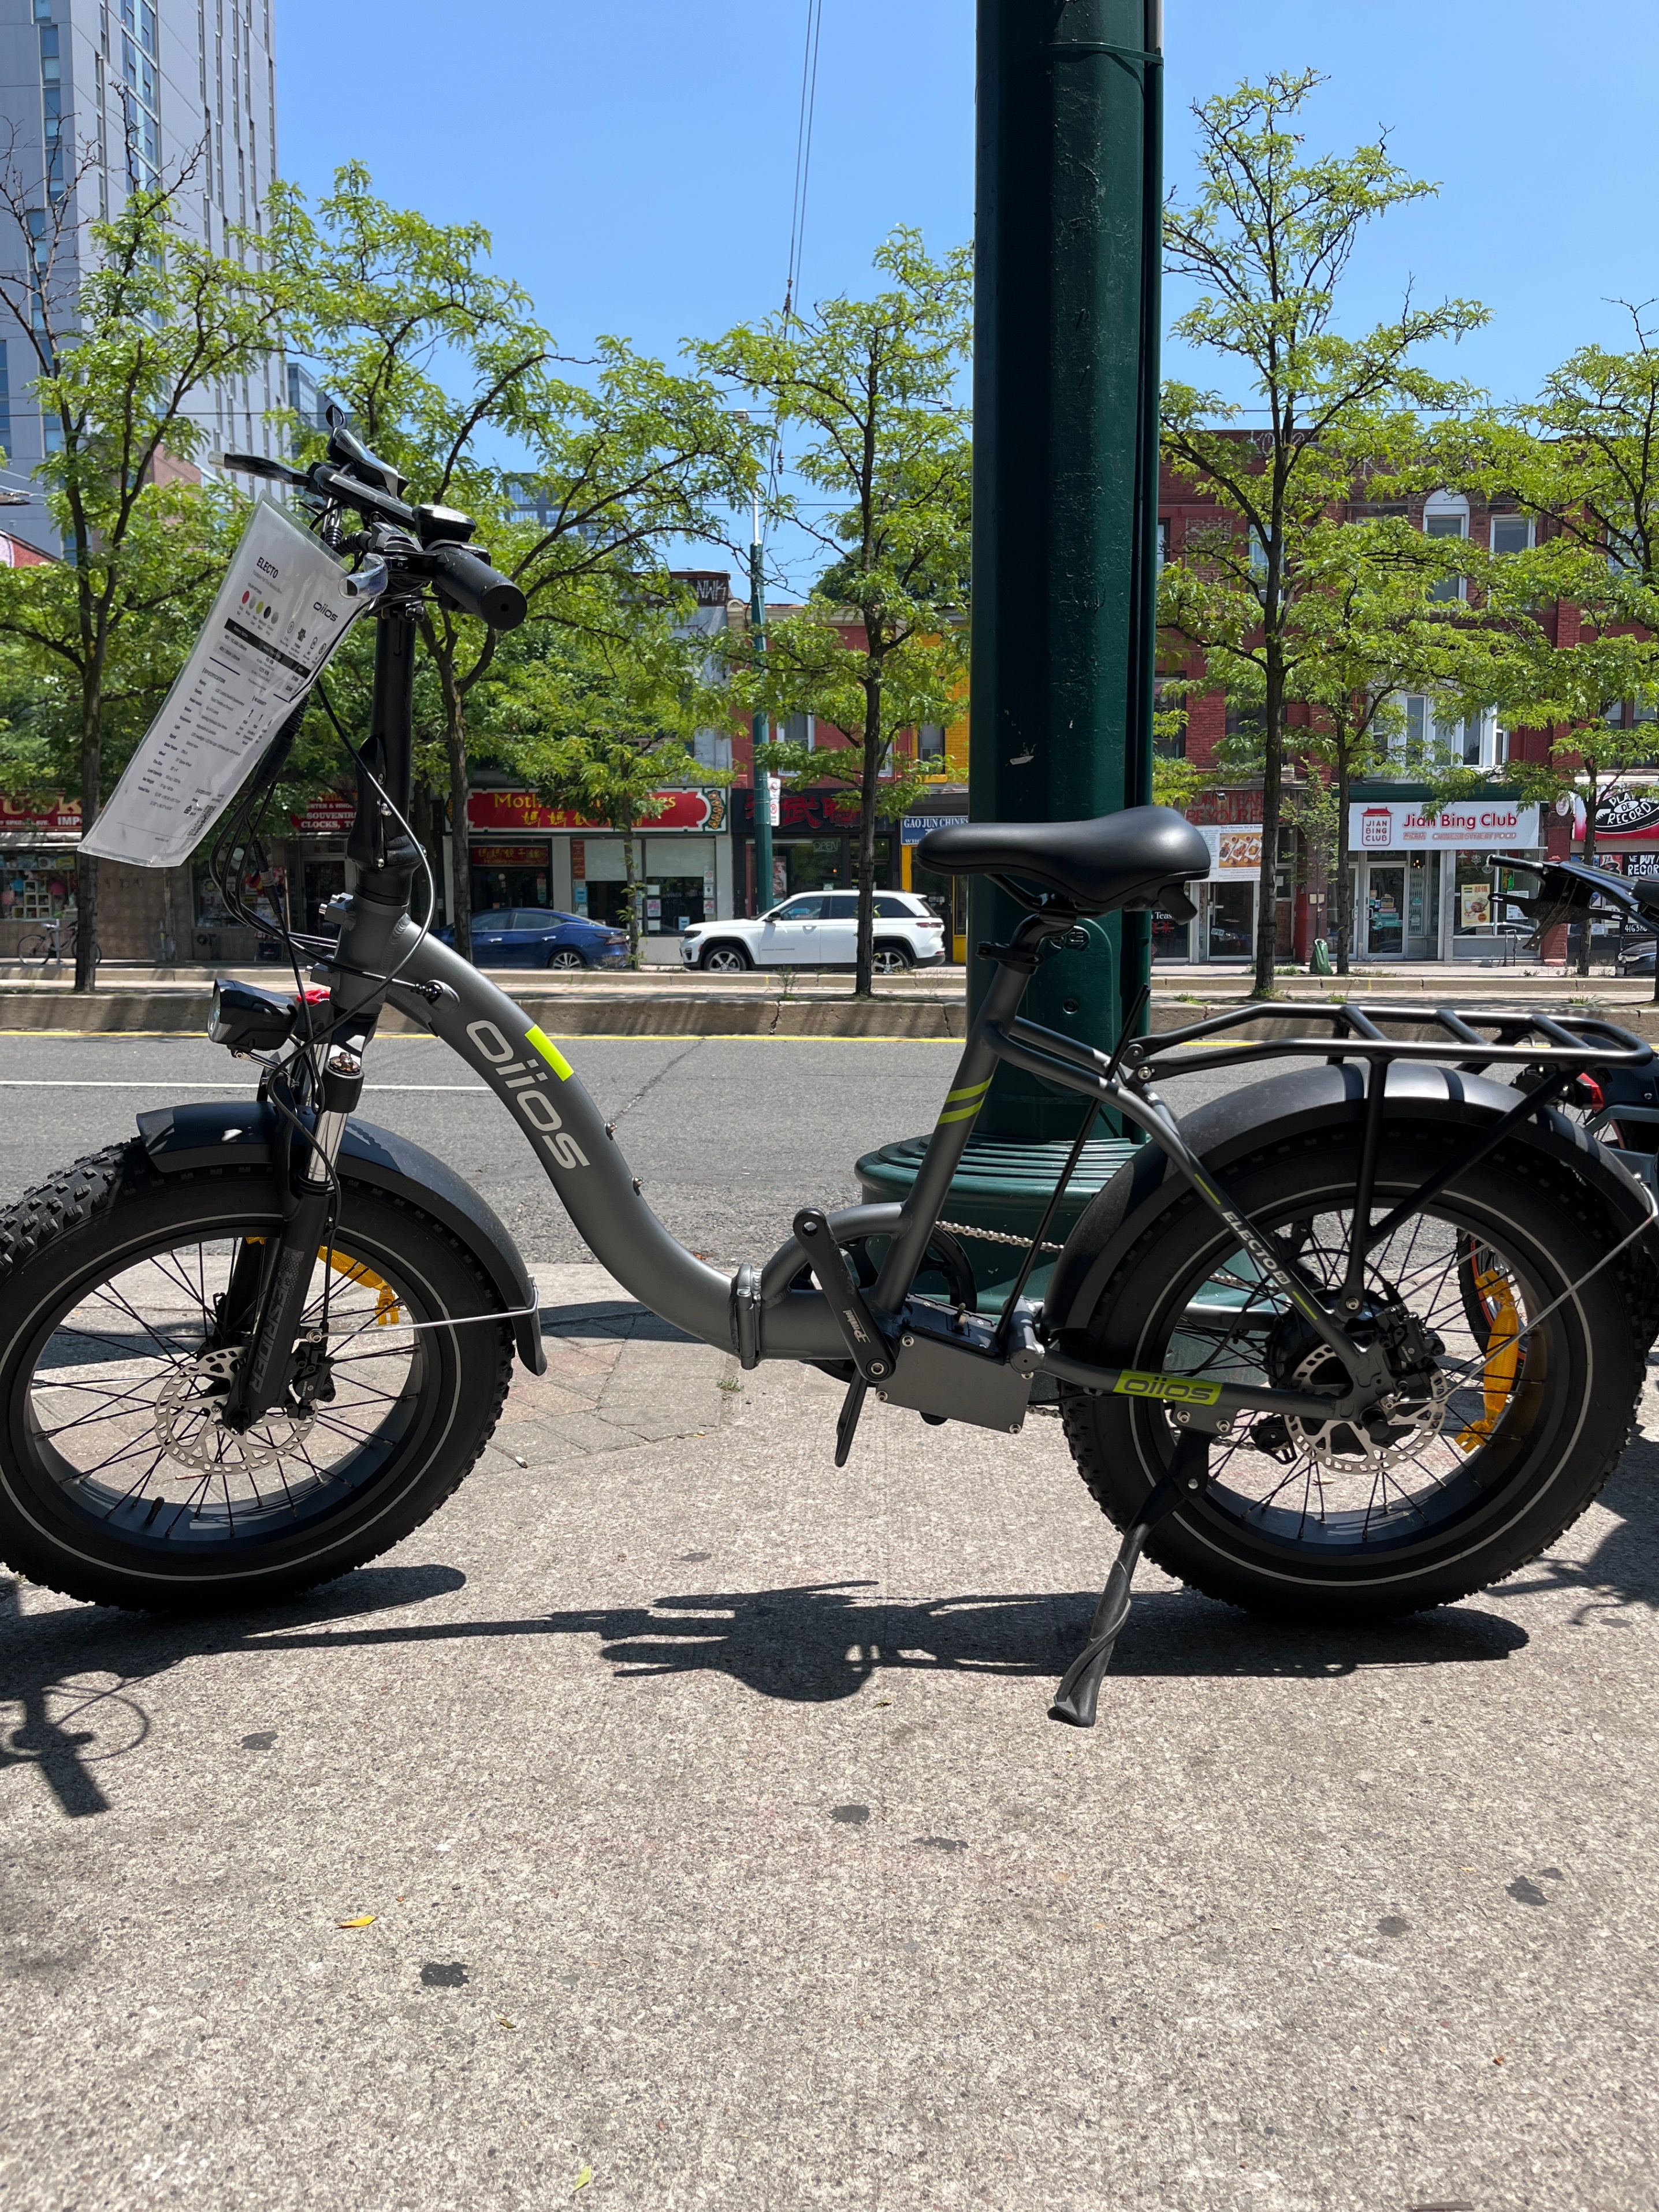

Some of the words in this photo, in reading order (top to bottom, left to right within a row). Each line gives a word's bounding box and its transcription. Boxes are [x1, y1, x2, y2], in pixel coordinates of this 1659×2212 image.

[256, 556, 278, 578] ELECTO
[313, 602, 338, 622] oiios
[1607, 802, 1651, 825] RECORD
[1621, 802, 1631, 811] DE
[58, 816, 82, 826] IMP
[903, 818, 921, 828] GAO
[922, 818, 938, 828] JUN
[1206, 809, 1249, 824] YOUR
[1403, 813, 1436, 828] Jian
[1441, 813, 1476, 831] Bing
[1480, 811, 1517, 827] Club
[813, 840, 838, 852] OPEN
[1629, 855, 1637, 863] WE
[1639, 855, 1655, 865] BUY
[1155, 911, 1172, 919] Teas
[1625, 925, 1635, 933] 416
[466, 1020, 590, 1169] oiios
[1222, 1211, 1278, 1270] ELECTO
[1124, 1377, 1213, 1401] oiios
